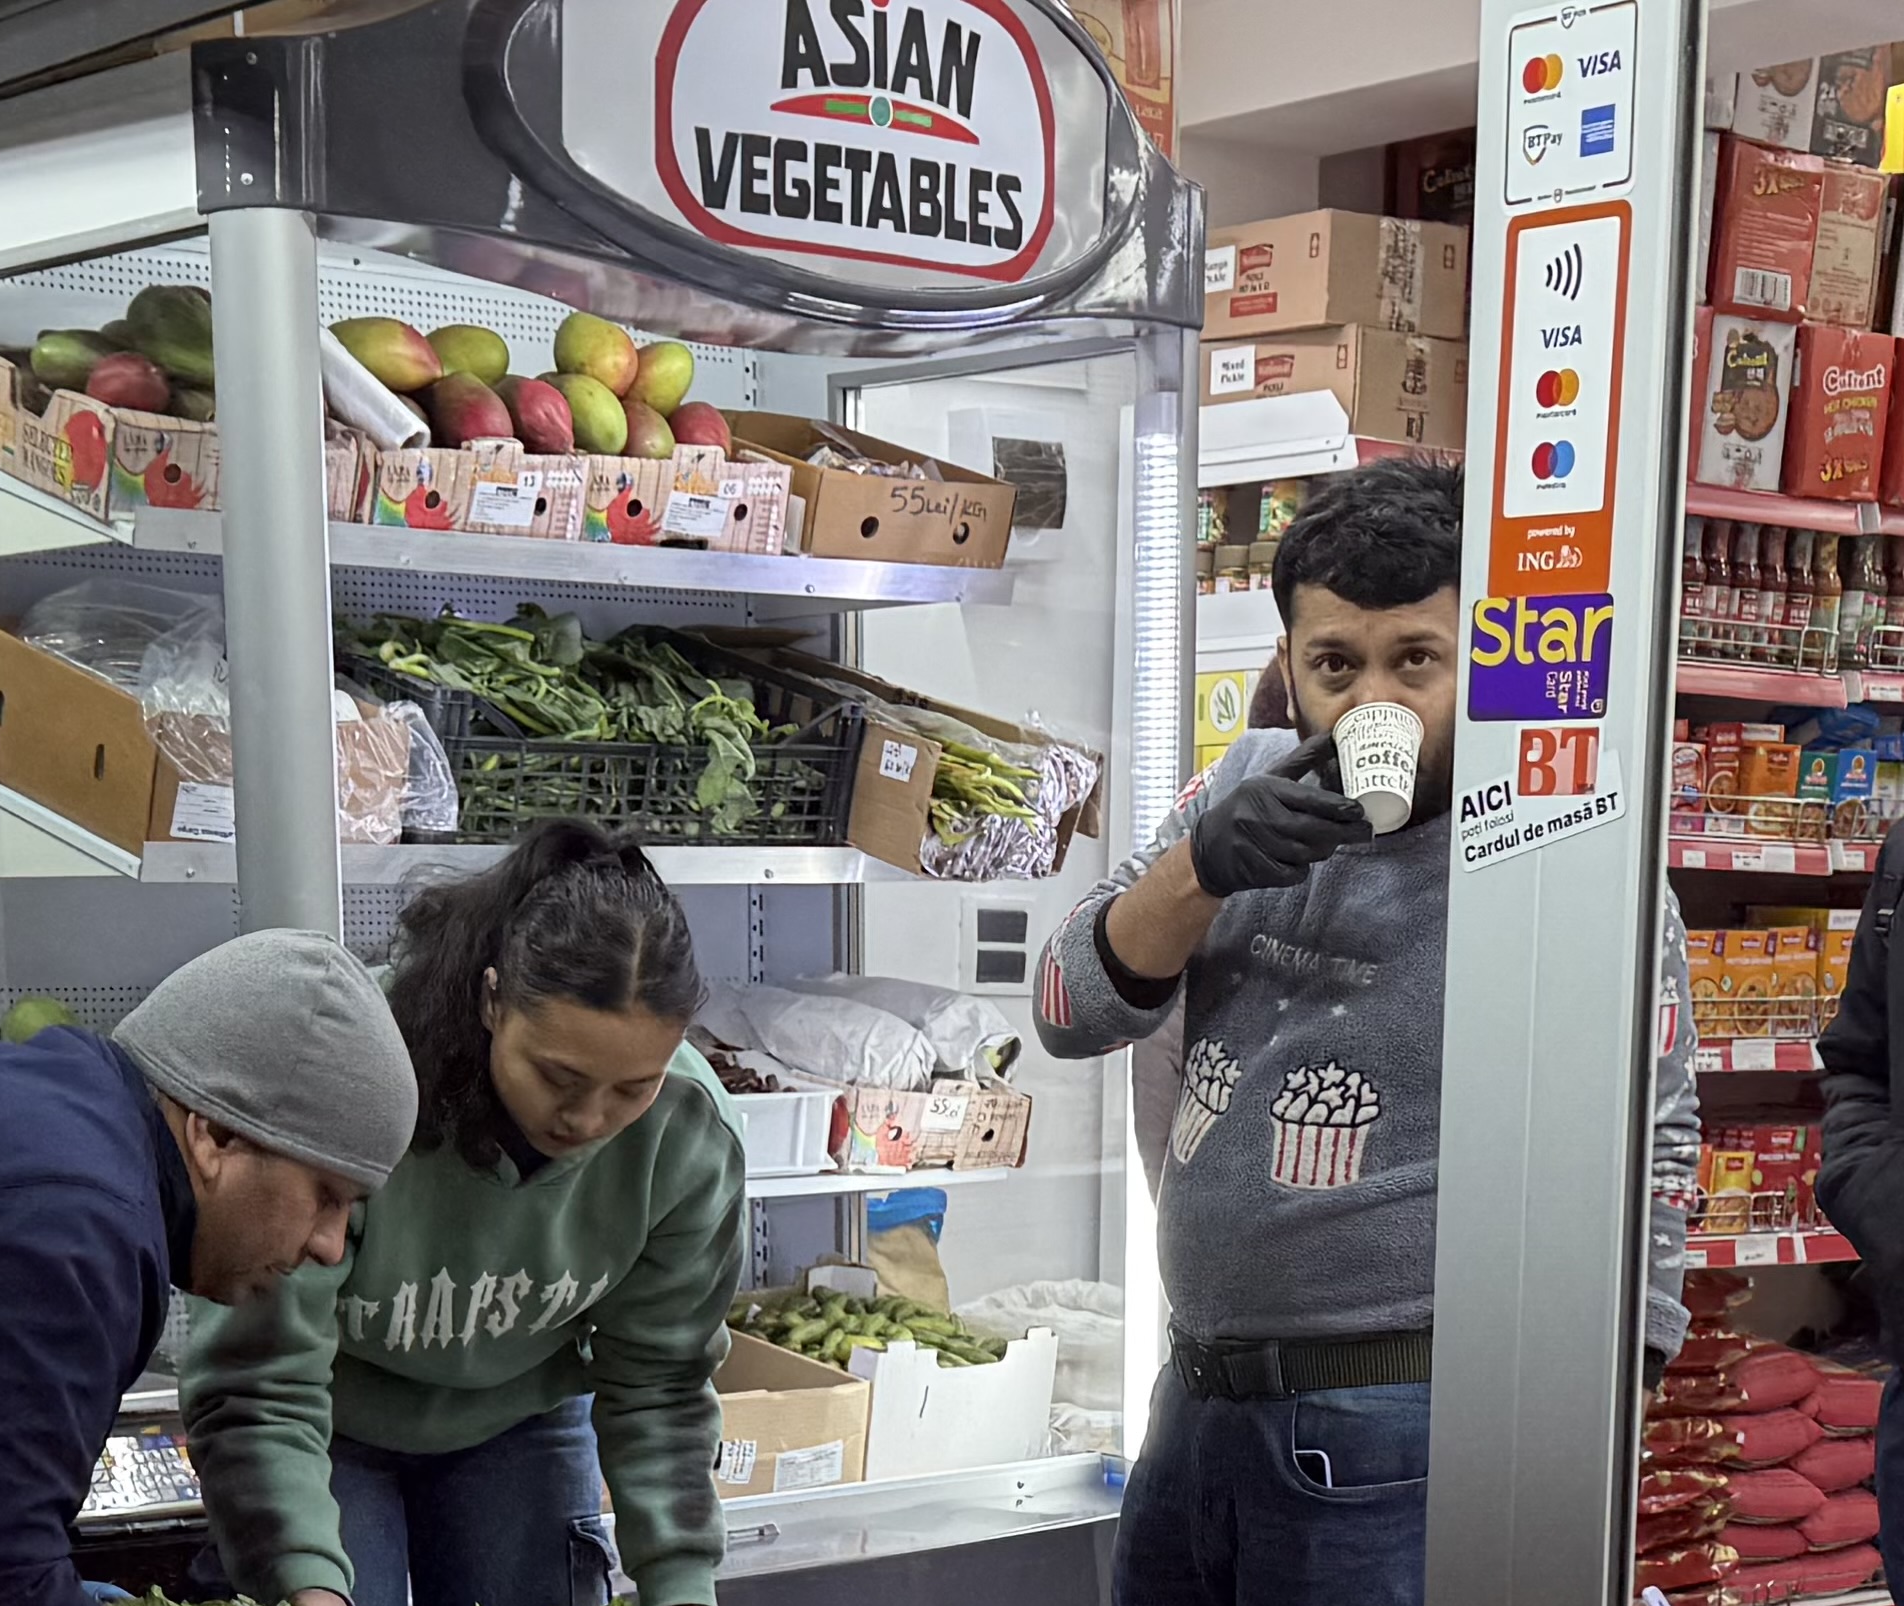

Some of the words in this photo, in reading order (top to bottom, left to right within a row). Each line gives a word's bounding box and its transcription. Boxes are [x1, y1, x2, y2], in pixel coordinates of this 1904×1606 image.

[1577, 50, 1622, 79] VISA
[1528, 134, 1543, 149] BT
[1544, 131, 1563, 148] Pay
[695, 126, 1024, 251] VEGETABLES
[1540, 324, 1582, 350] VISA
[1527, 526, 1560, 539] powered
[1562, 524, 1575, 538] by
[1517, 550, 1555, 572] ING
[1471, 595, 1614, 666] Star
[1558, 671, 1572, 714] Star
[1518, 728, 1598, 795] BT
[1459, 780, 1513, 823] AICI
[1464, 831, 1521, 863] Cardul
[1524, 823, 1545, 843] de
[1596, 792, 1619, 815] BT
[1251, 934, 1319, 971] CINEMA
